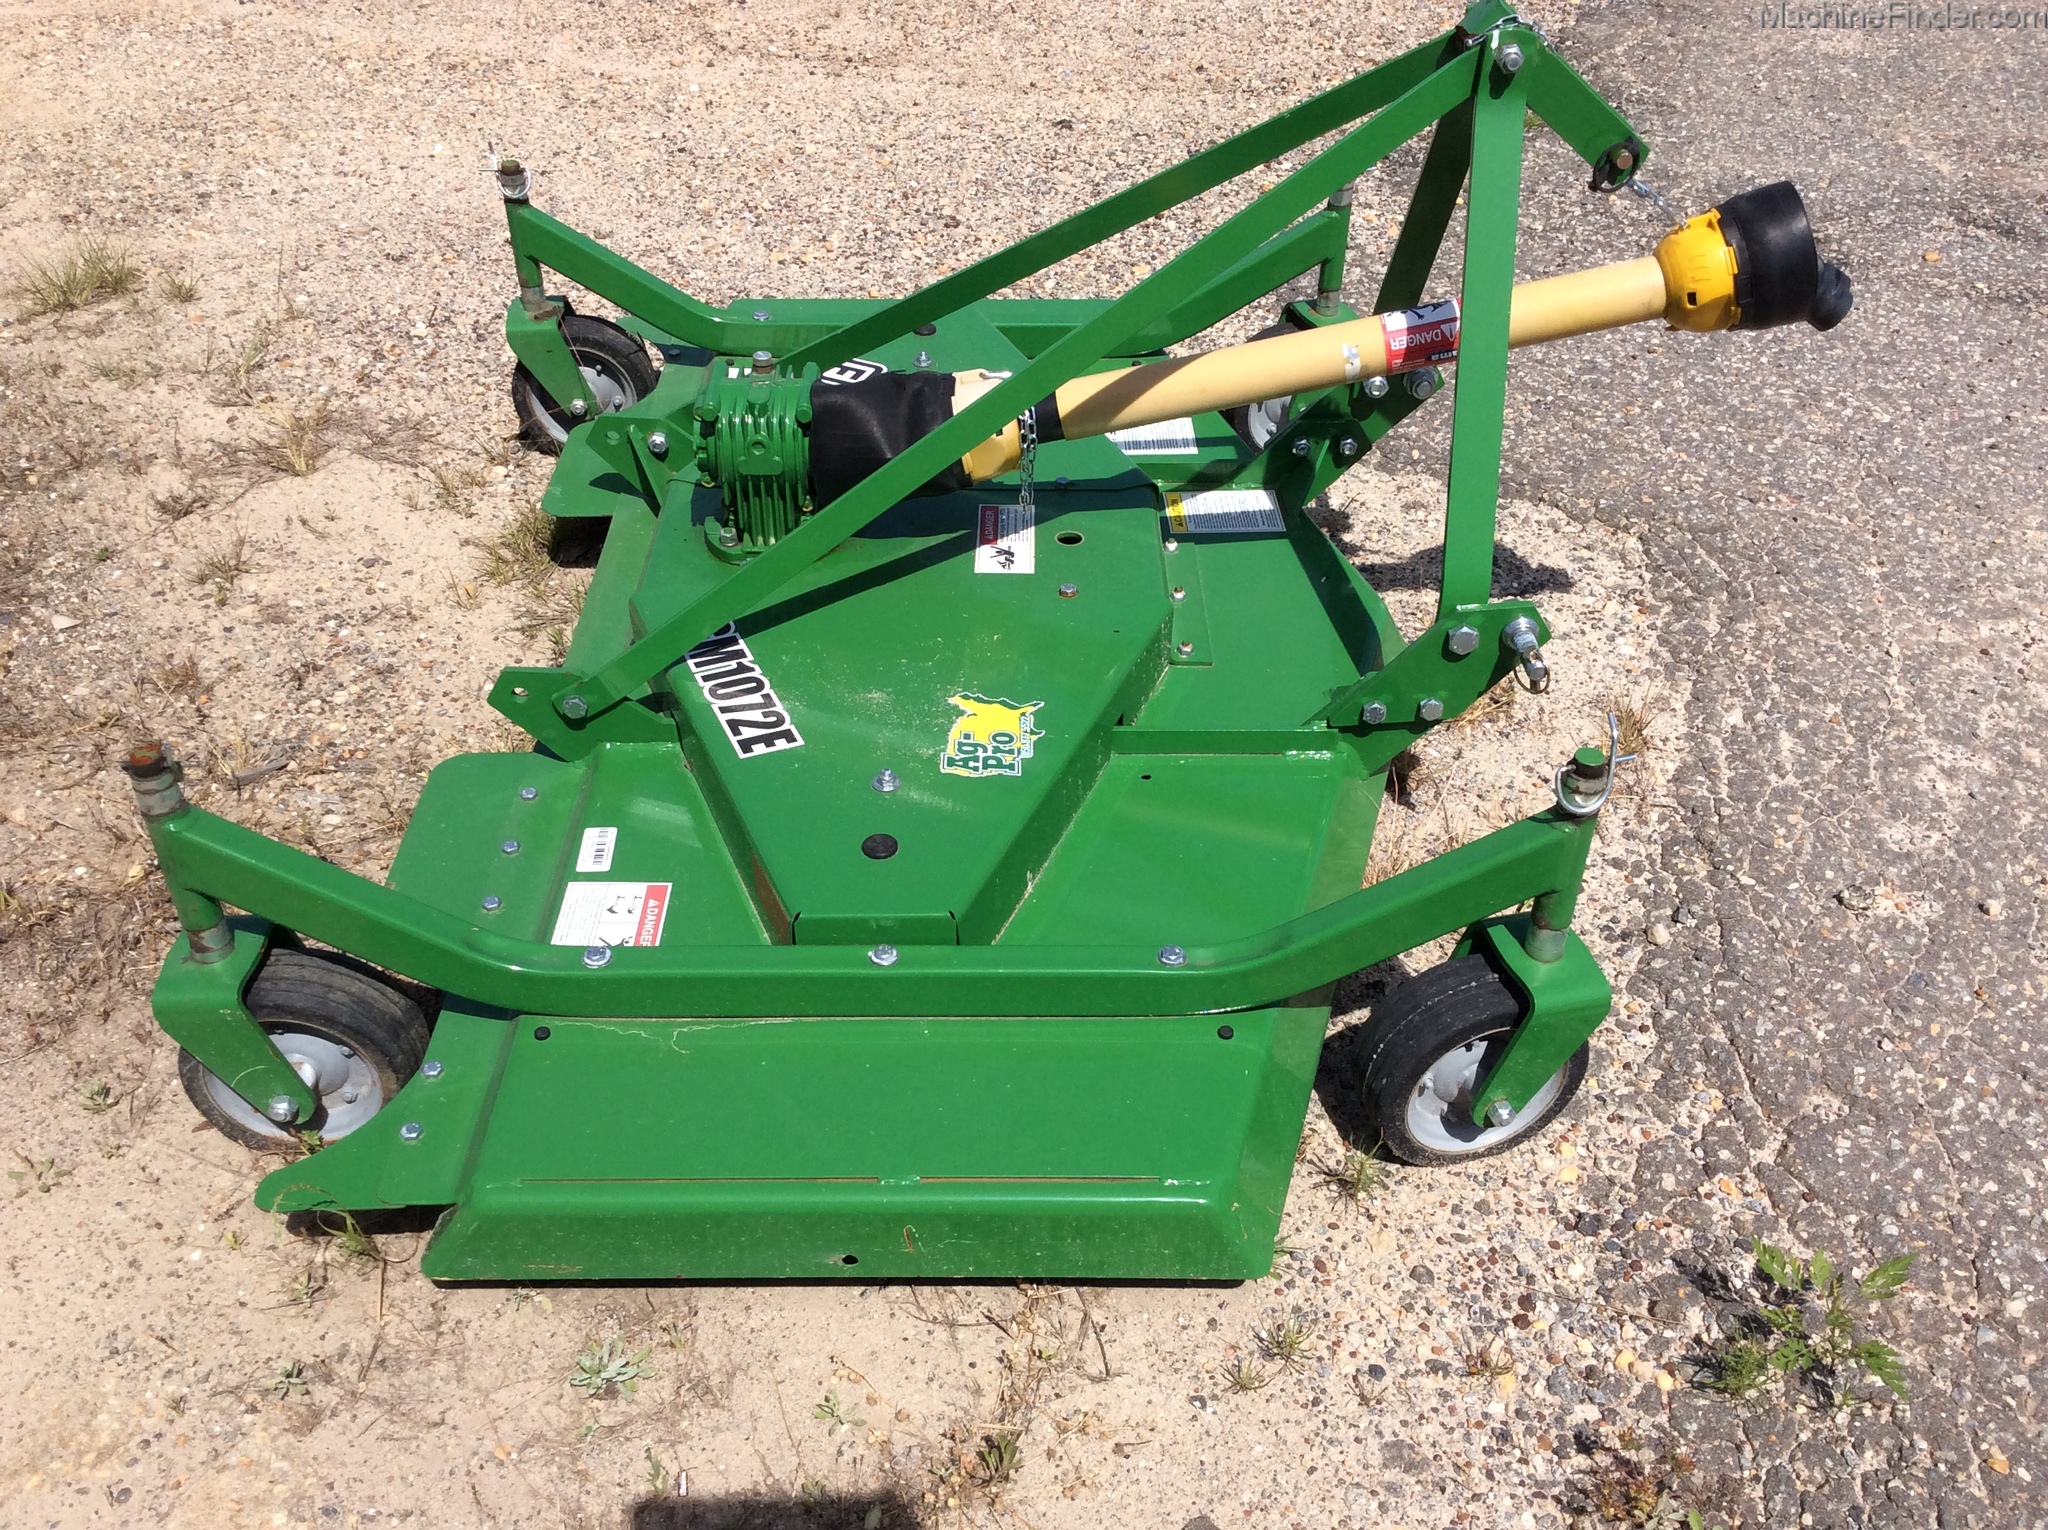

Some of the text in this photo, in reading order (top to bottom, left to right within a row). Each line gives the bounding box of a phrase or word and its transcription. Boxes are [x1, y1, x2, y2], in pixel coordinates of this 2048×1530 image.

[1390, 329, 1442, 351] DANGER
[985, 510, 995, 535] DANGER
[1171, 498, 1183, 522] CAUTION
[688, 622, 801, 757] M1072E
[981, 731, 1016, 773] Pro
